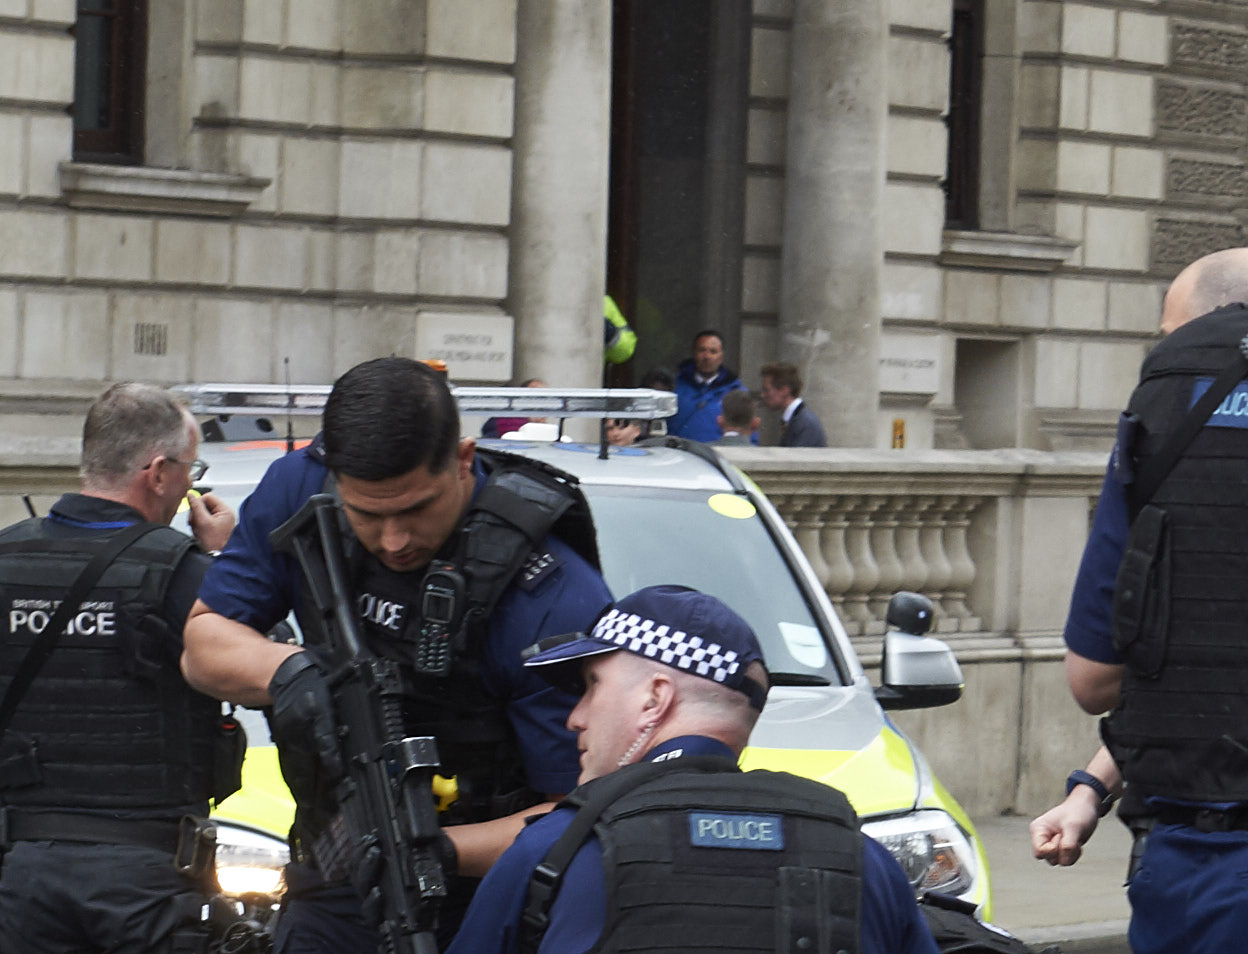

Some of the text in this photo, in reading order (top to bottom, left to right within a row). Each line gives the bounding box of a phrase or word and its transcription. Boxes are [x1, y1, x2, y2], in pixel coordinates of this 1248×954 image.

[9, 609, 117, 636] POICE
[359, 591, 405, 631] OLICE
[698, 818, 773, 842] POLICE
